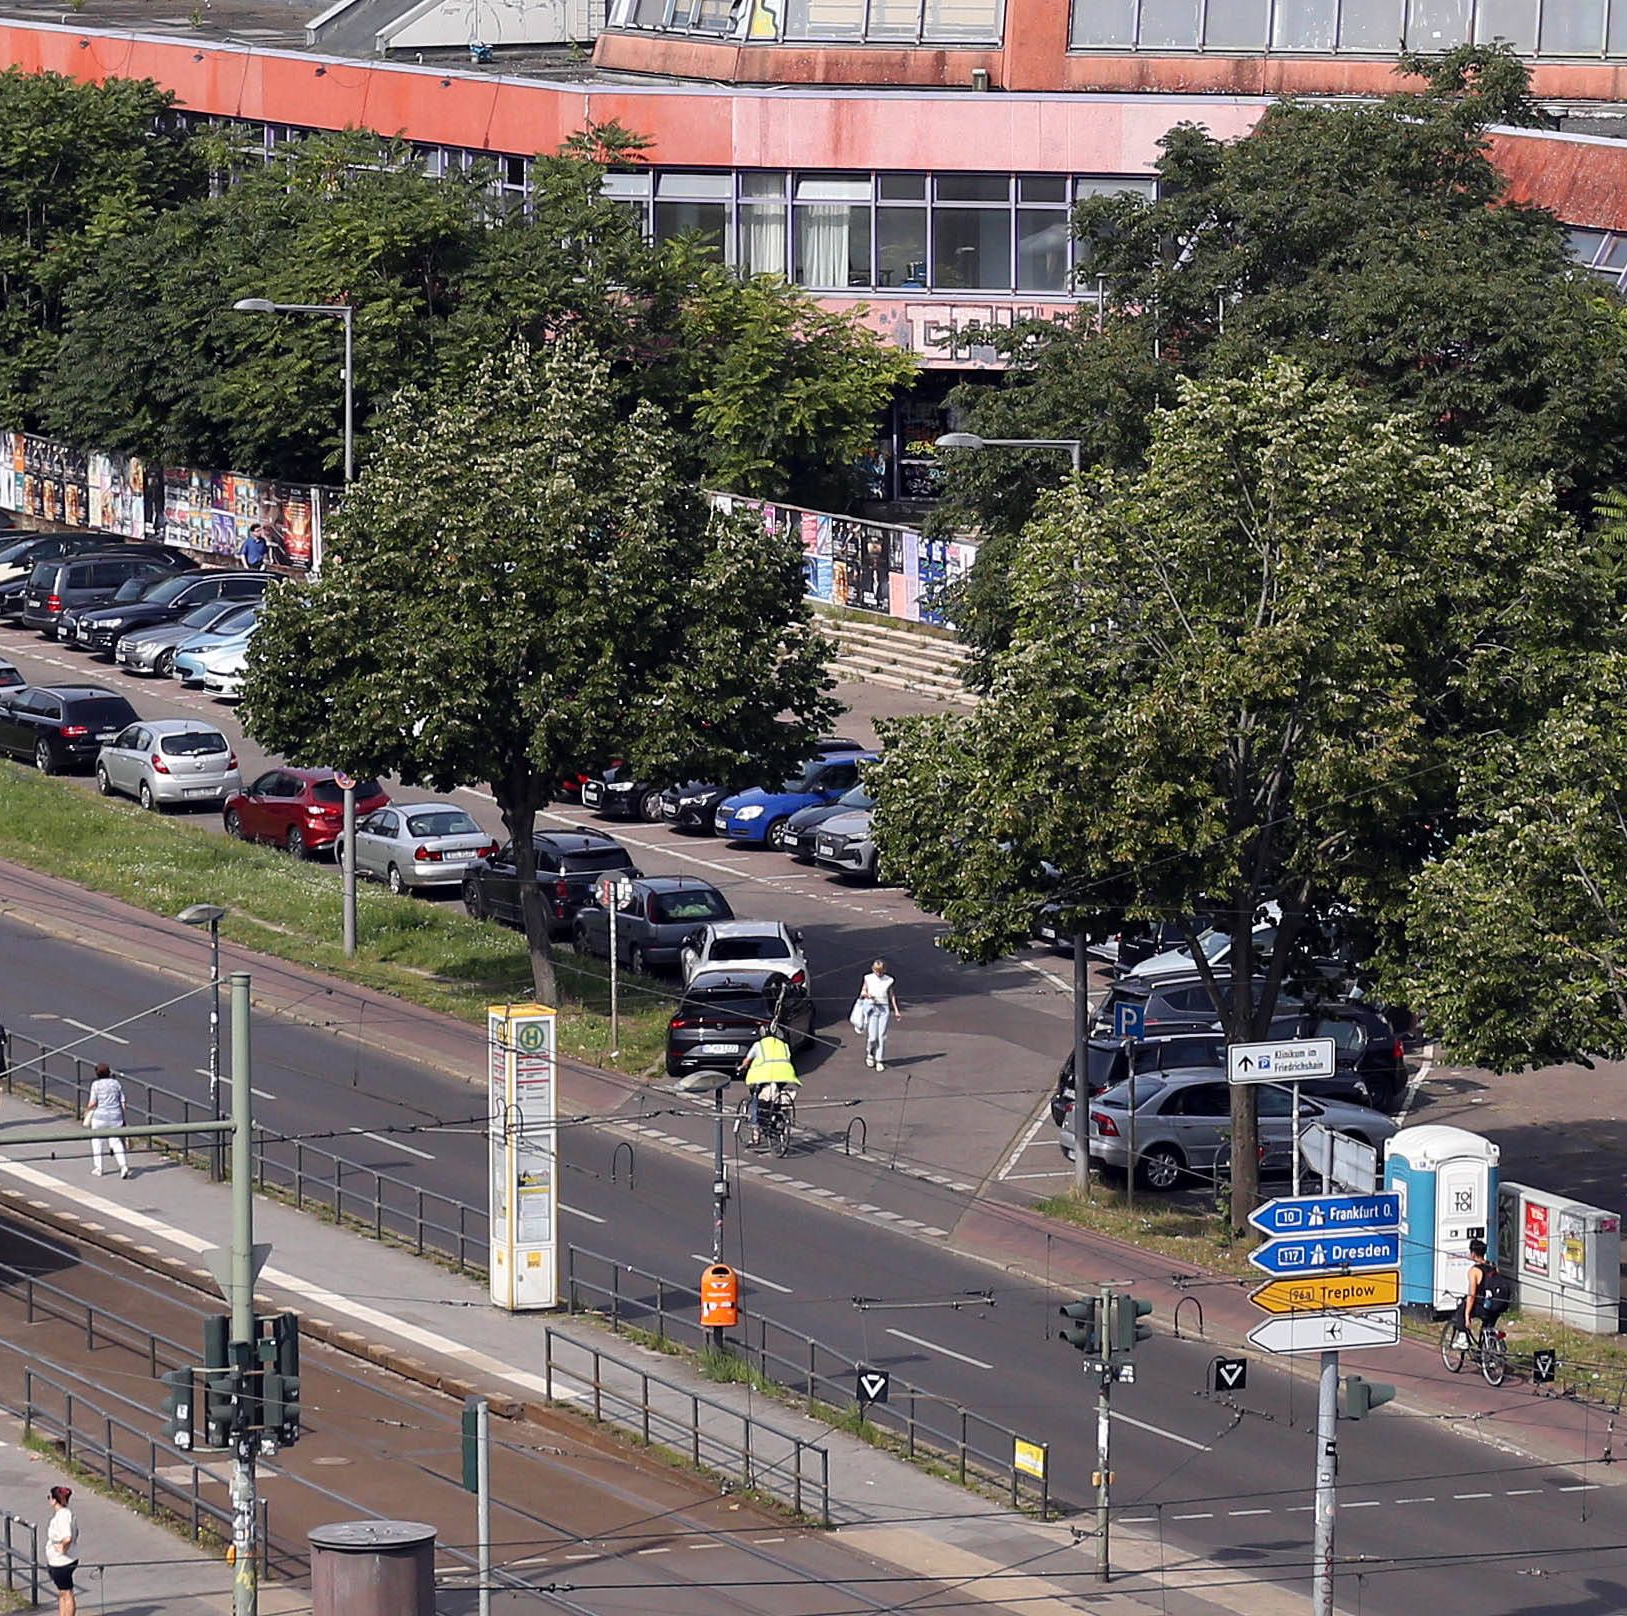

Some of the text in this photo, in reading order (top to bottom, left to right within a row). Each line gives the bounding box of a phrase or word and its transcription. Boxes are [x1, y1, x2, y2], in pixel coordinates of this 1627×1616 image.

[1122, 1008, 1137, 1034] P
[1275, 1048, 1317, 1060] Klinikum im
[1274, 1059, 1324, 1073] Friedrichshain
[1283, 1212, 1294, 1223] 10
[1329, 1203, 1379, 1221] Frankfurt
[1283, 1244, 1390, 1262] 117 Dresden
[1293, 1285, 1375, 1302] 96a Treptow
